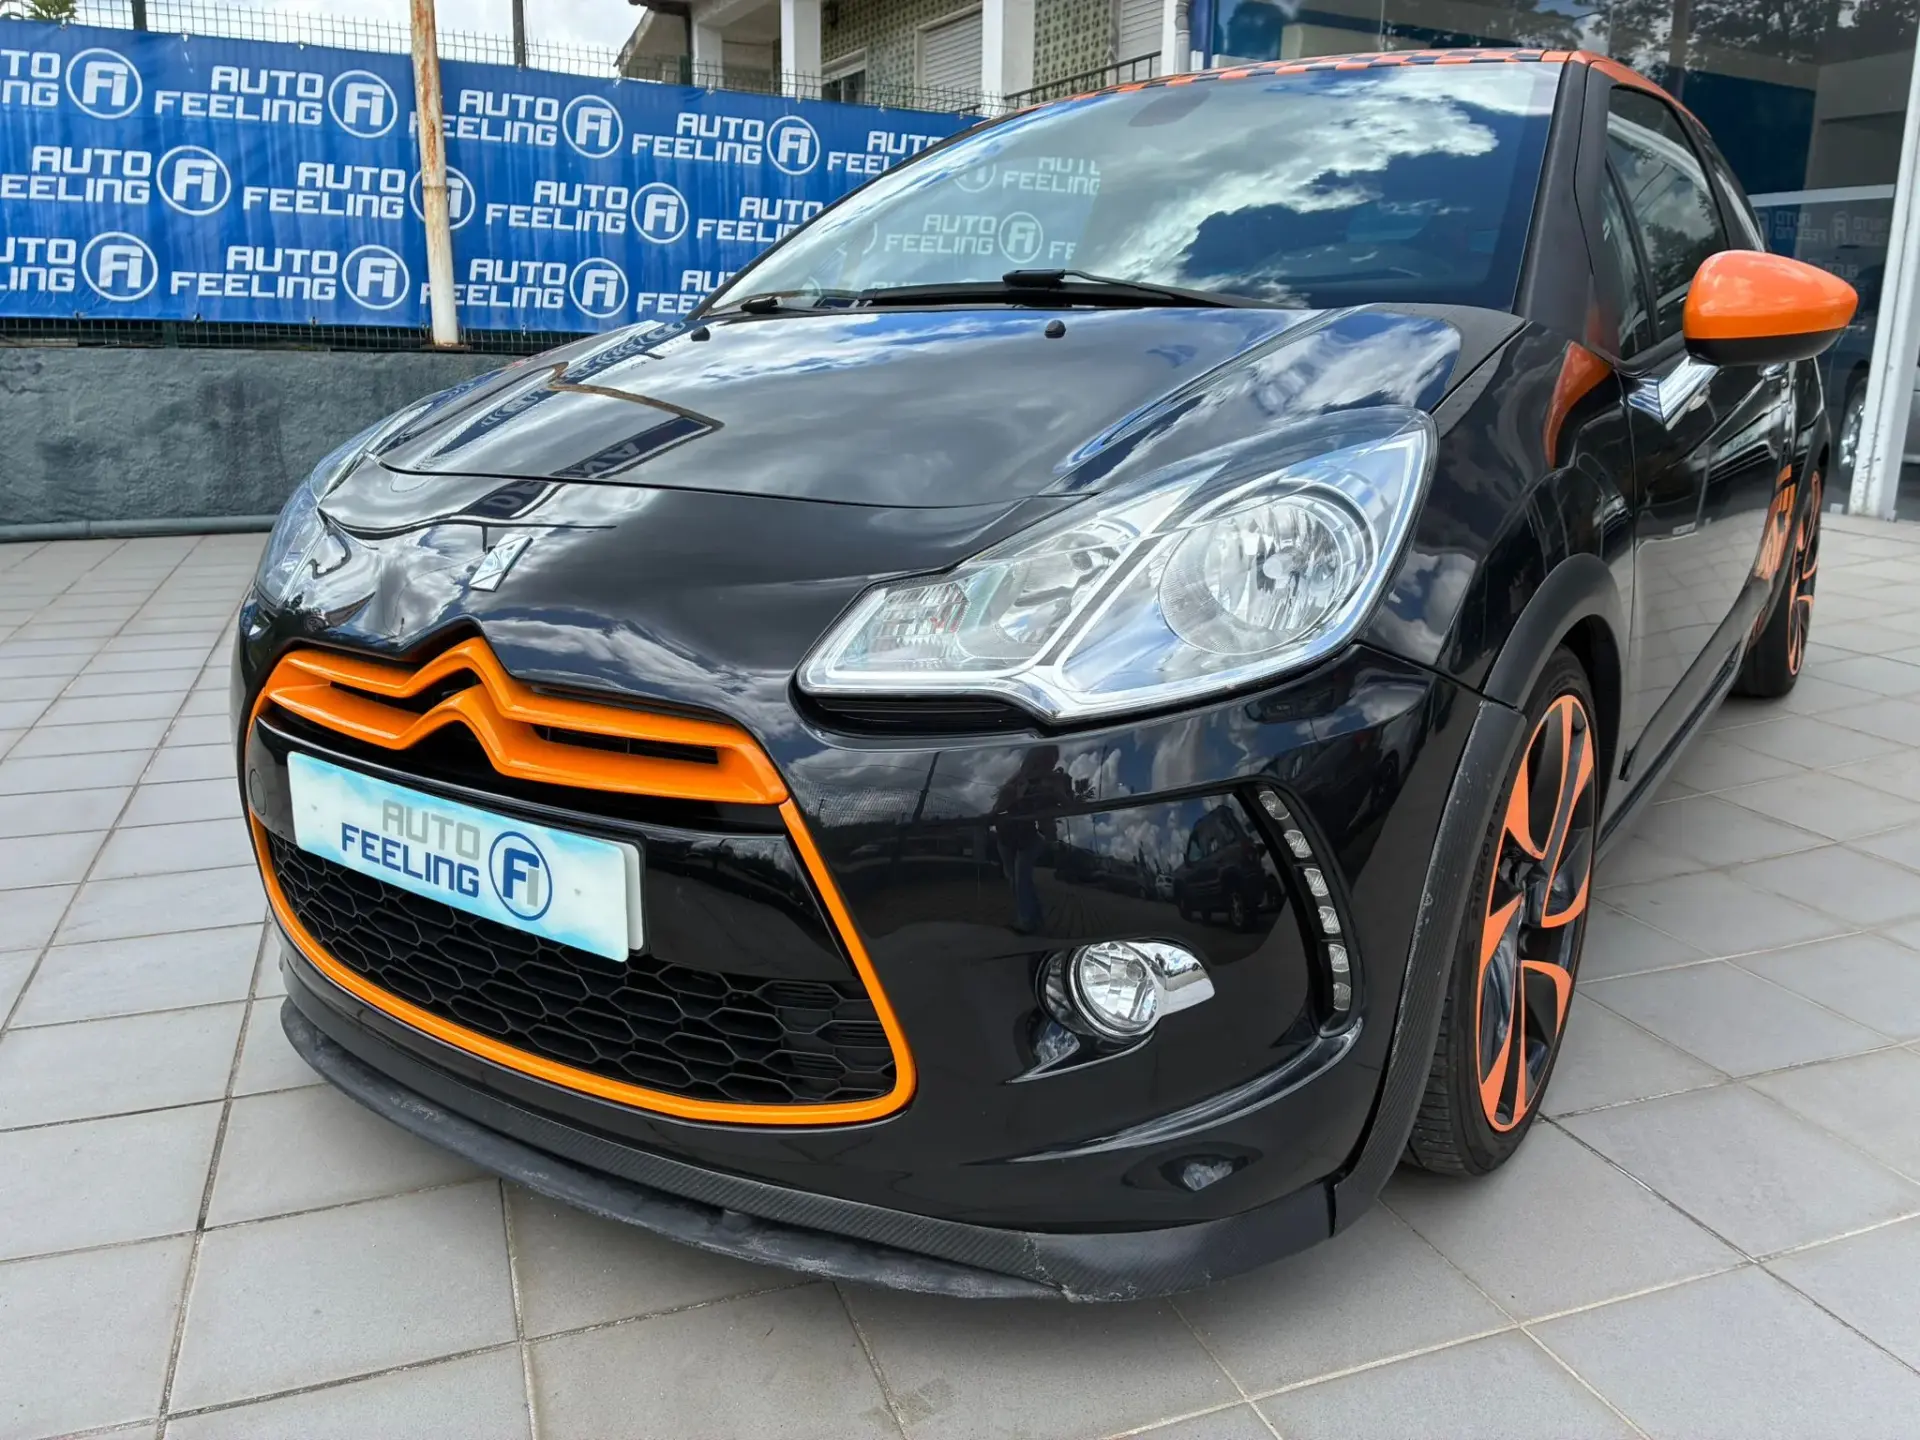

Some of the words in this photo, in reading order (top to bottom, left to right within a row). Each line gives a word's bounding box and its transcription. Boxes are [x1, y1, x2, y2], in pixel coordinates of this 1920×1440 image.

[210, 65, 324, 99] AUTO
[154, 90, 324, 126] FEELING
[459, 89, 560, 121] AUTO
[675, 112, 765, 143] AUTO
[31, 145, 152, 178] AUTO
[631, 134, 764, 165] FEELING
[827, 151, 895, 175] FEEL
[297, 161, 406, 194] AUTO
[242, 187, 405, 220] FEELING
[532, 180, 630, 211] AUTO
[485, 204, 628, 234] FEELING
[922, 213, 998, 235] AUTO
[226, 245, 338, 275] AUTO
[884, 233, 995, 256] FEELING
[0, 266, 76, 292] ING
[170, 271, 338, 301] FEELING
[468, 258, 567, 288] AUTO
[680, 269, 737, 293] AU
[381, 798, 481, 861] AUTO
[340, 821, 480, 899] FEELING
